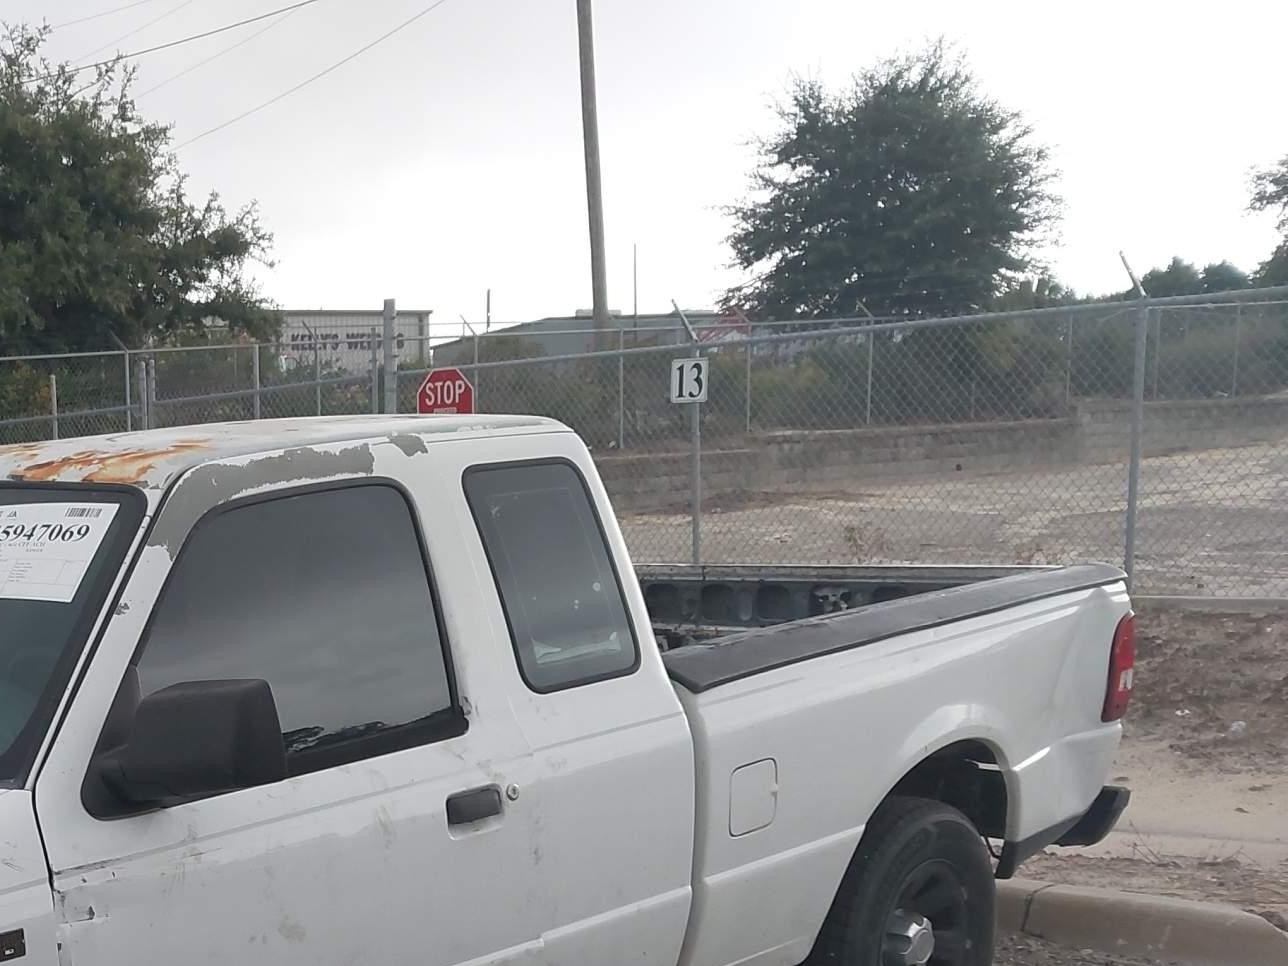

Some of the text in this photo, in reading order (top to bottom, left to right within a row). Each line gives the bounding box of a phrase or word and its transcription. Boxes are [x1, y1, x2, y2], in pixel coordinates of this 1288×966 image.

[346, 333, 404, 351] WELDG
[425, 380, 465, 406] STOP
[676, 362, 703, 398] 13
